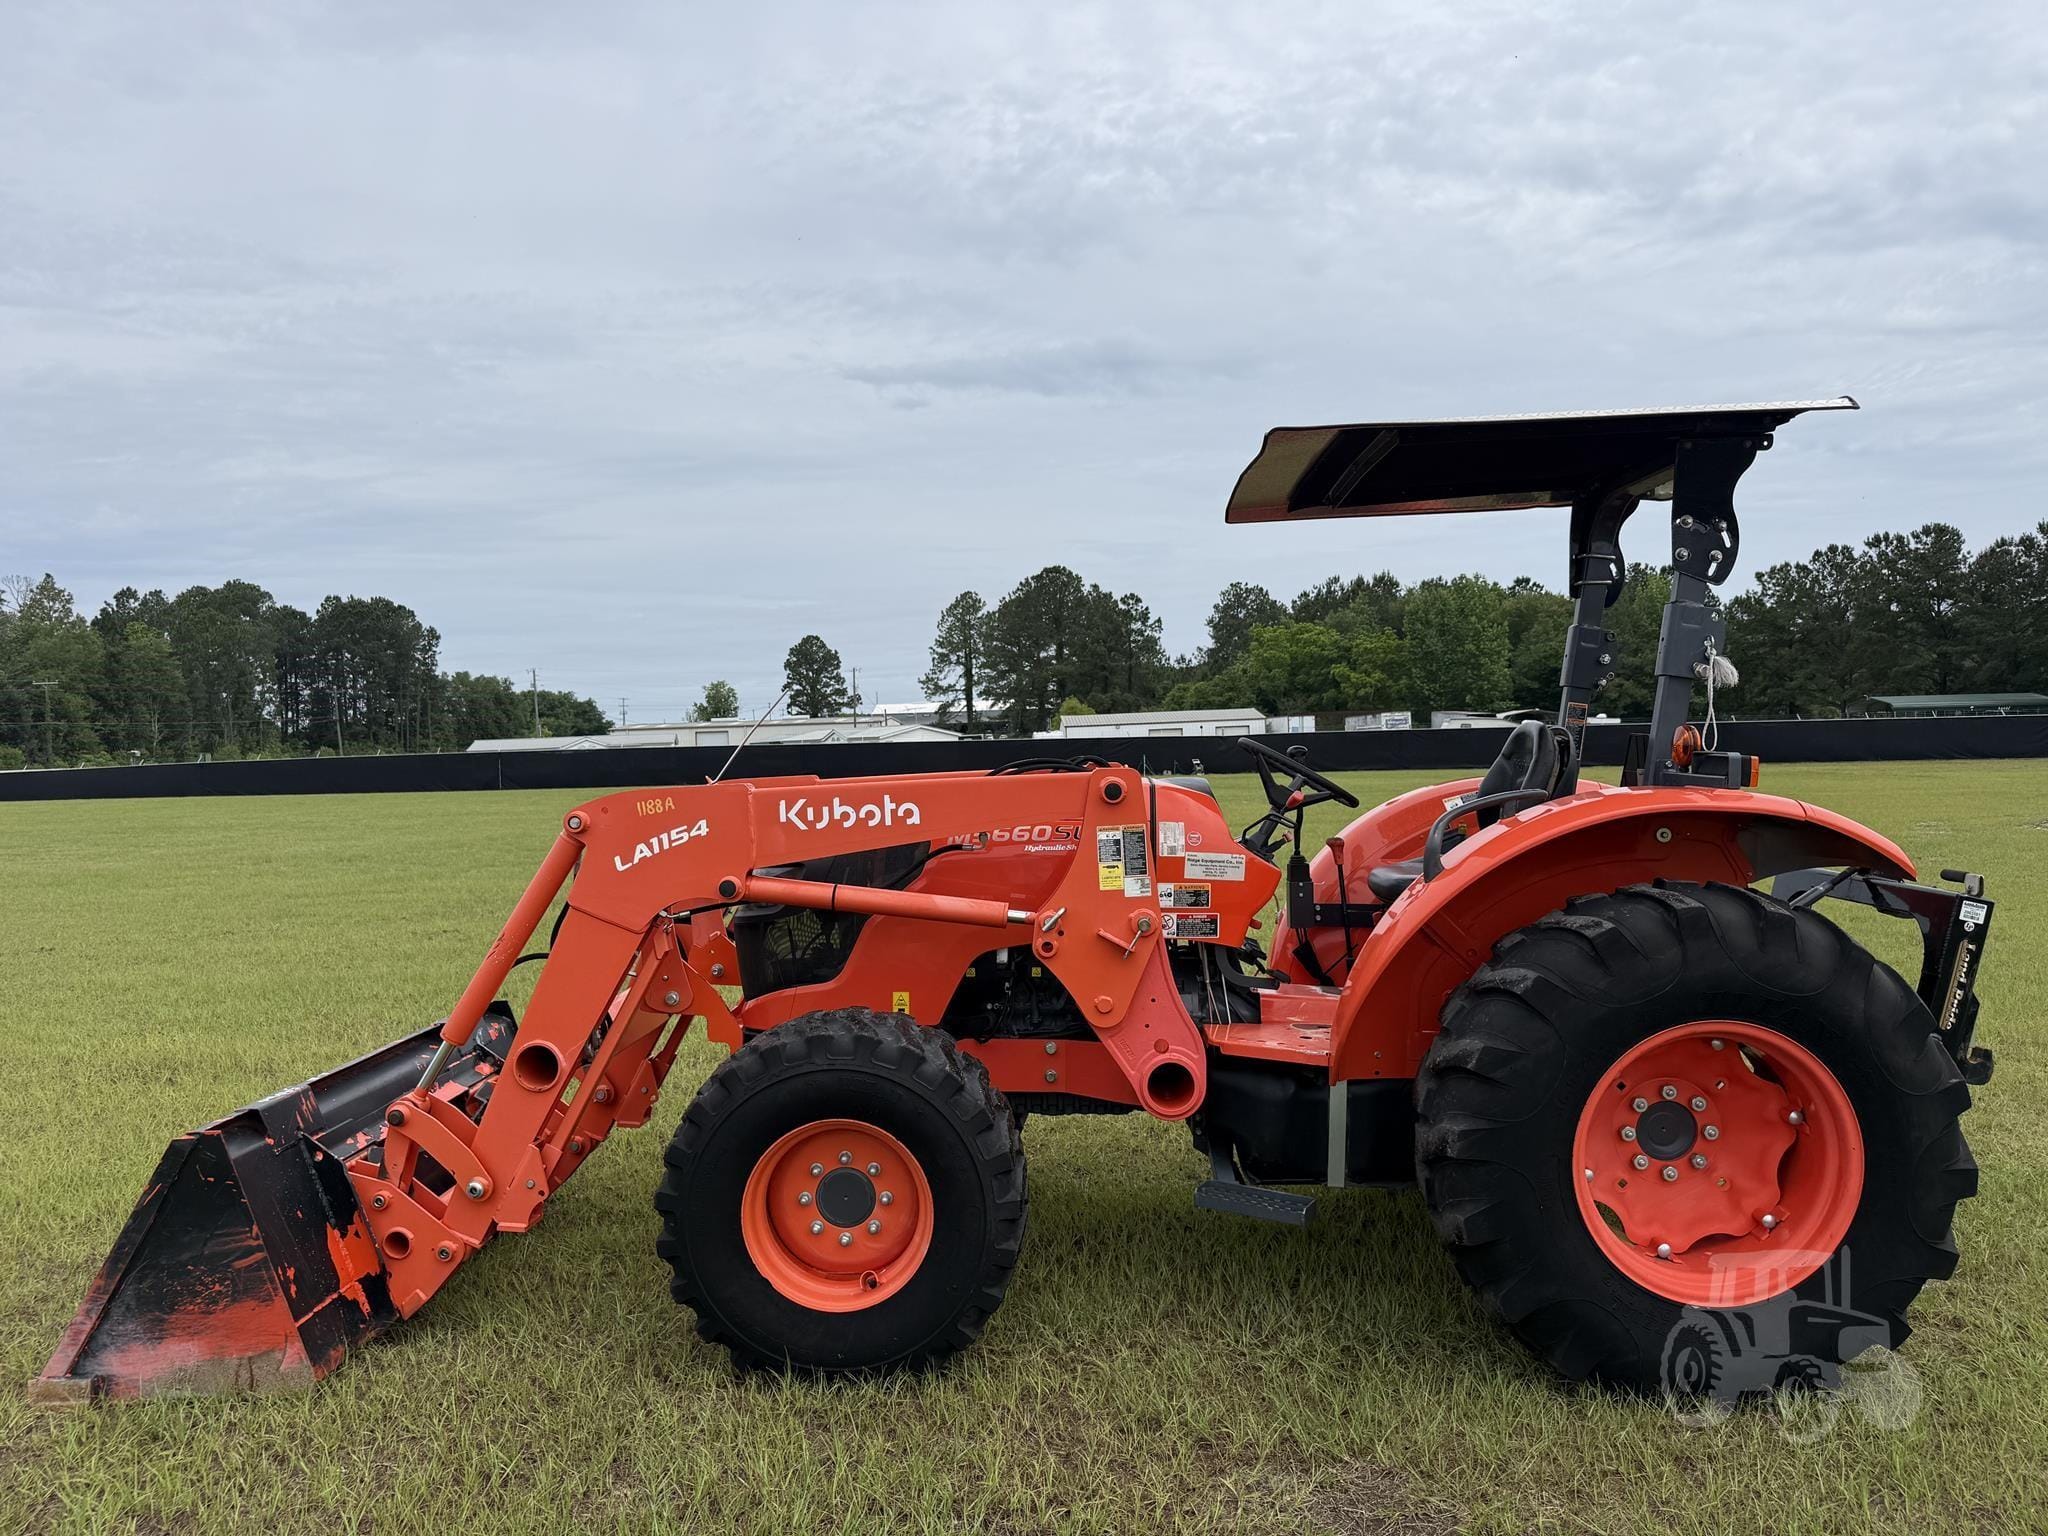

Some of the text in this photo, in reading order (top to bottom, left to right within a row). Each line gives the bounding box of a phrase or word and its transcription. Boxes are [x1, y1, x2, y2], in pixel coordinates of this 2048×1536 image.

[779, 795, 920, 830] Kubota
[614, 818, 710, 872] LA1154
[1945, 943, 1976, 1030] Land Pride
